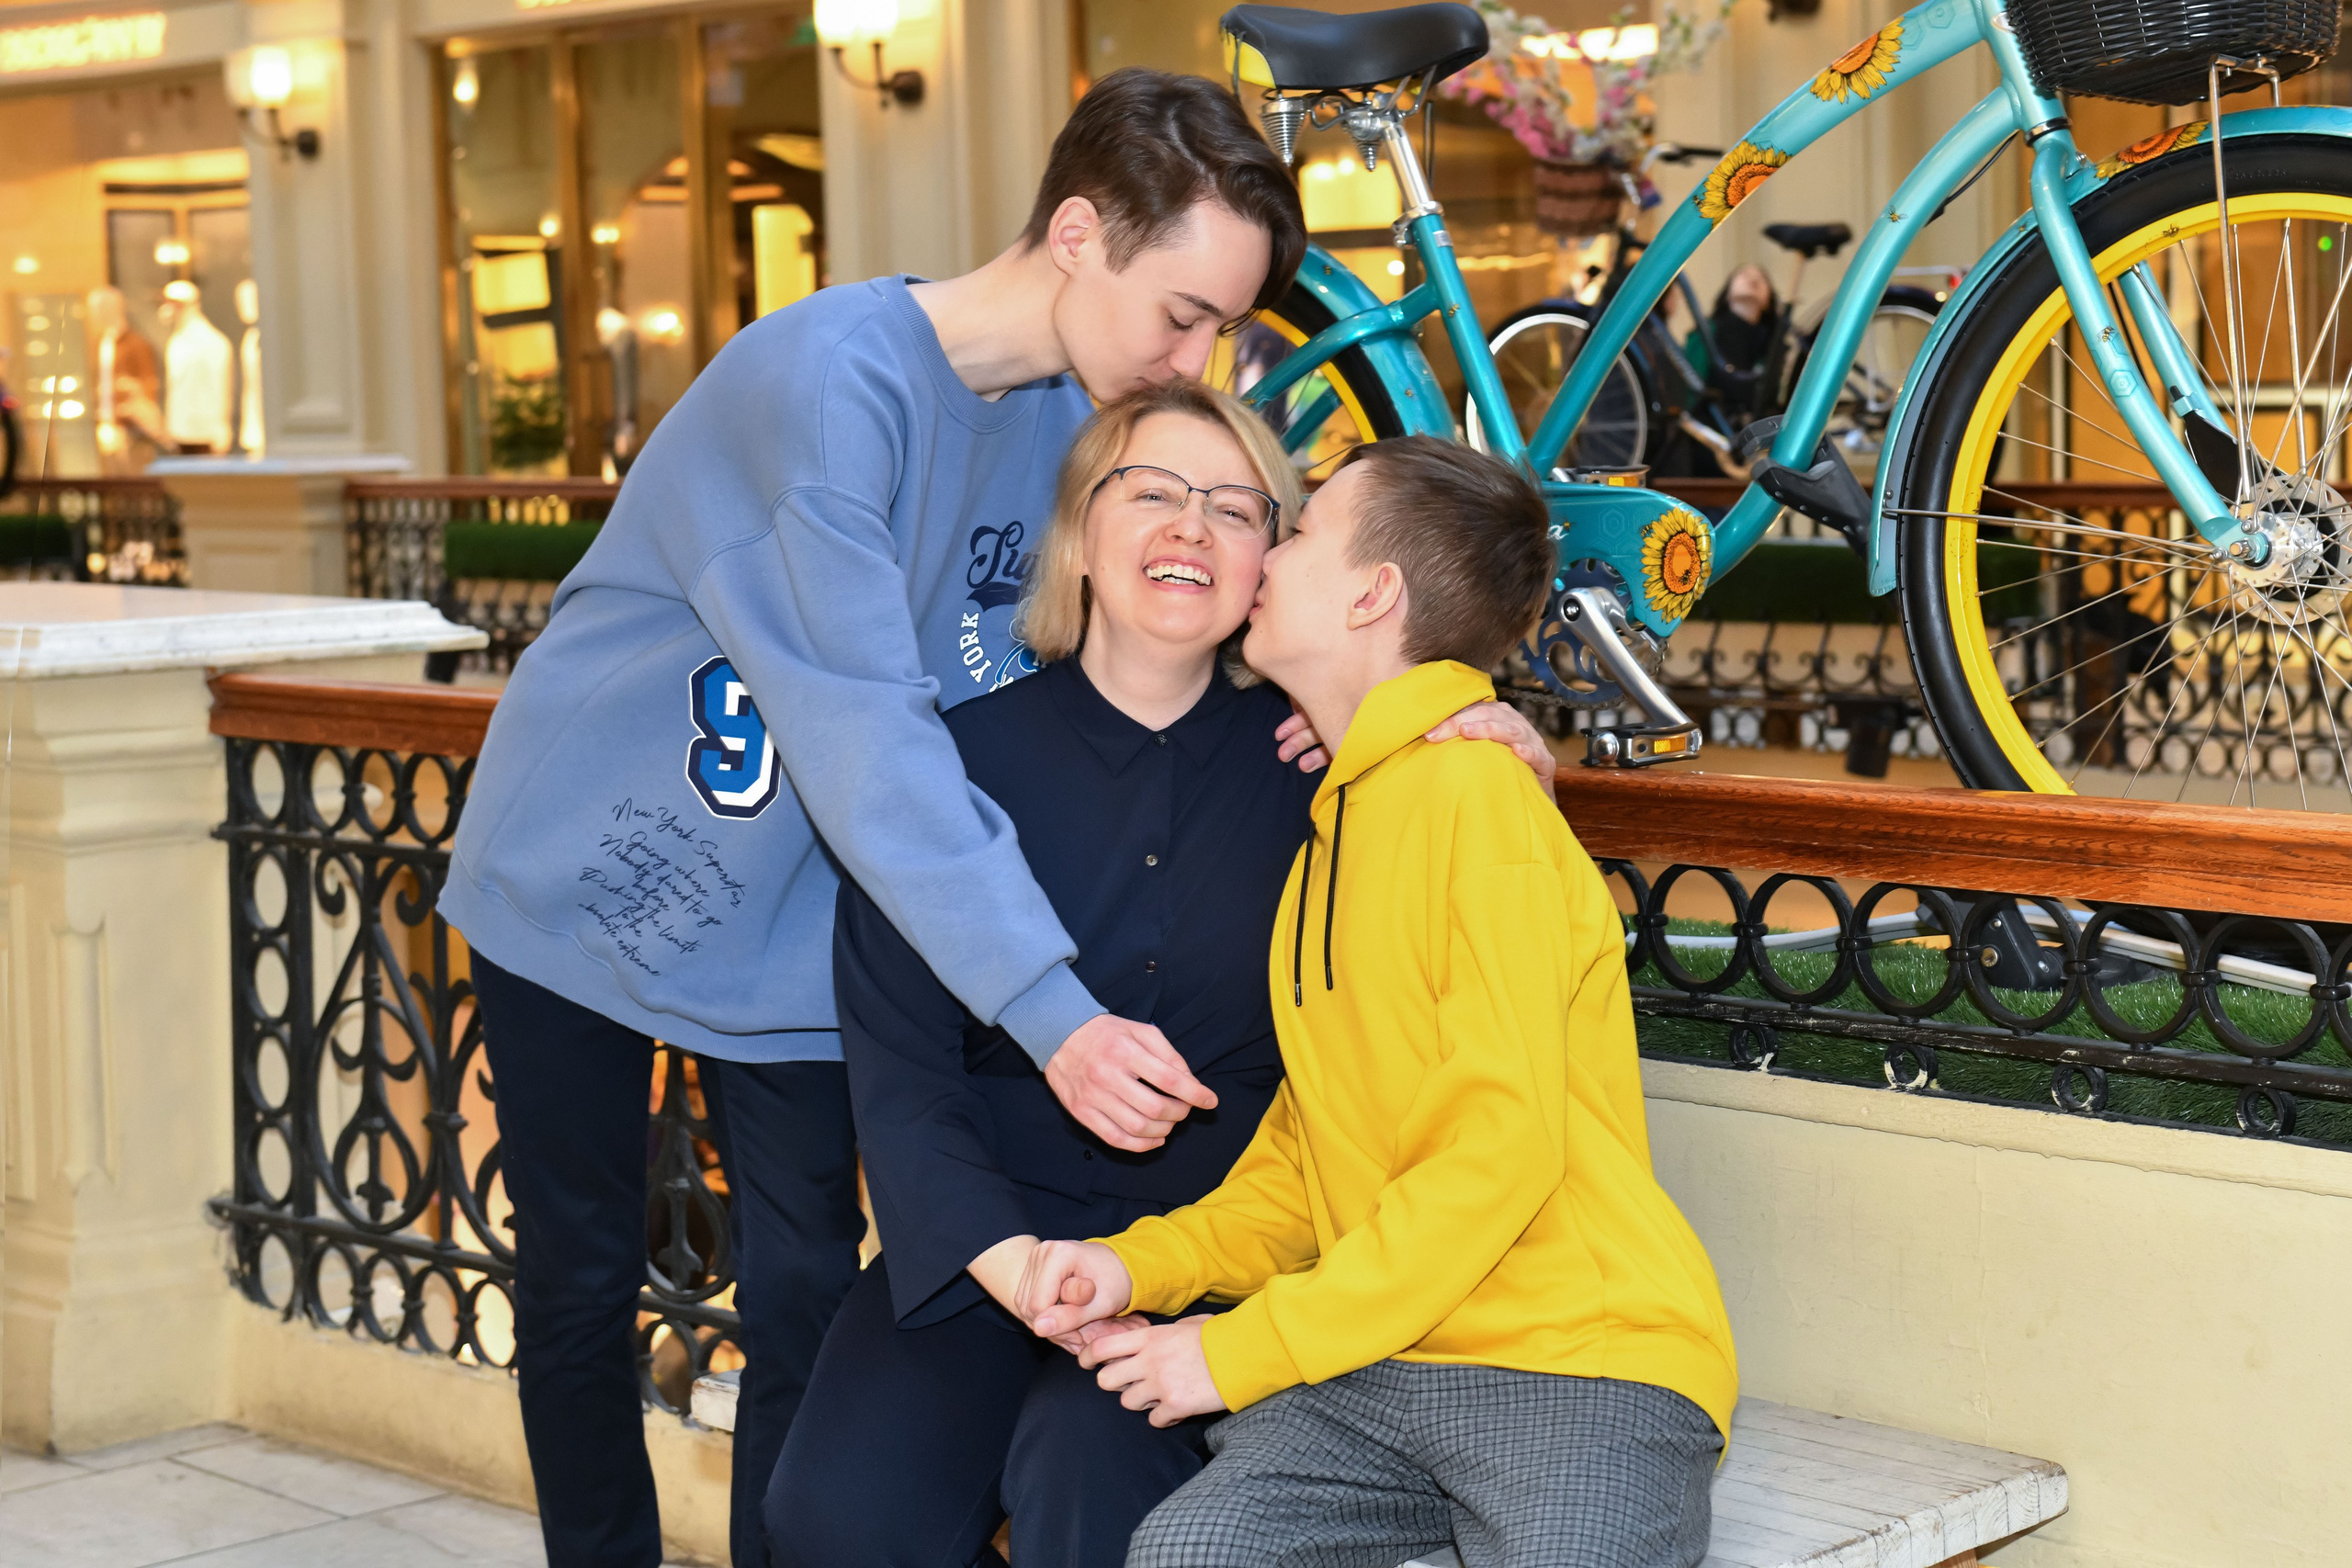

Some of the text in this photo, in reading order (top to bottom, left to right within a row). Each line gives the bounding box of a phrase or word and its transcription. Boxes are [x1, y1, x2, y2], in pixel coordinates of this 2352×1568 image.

[959, 612, 992, 683] YORK
[599, 833, 724, 928] Nobody dared to go
[612, 797, 746, 908] New York Superstar
[626, 831, 710, 897] Going where
[614, 904, 642, 938] to the
[632, 878, 670, 911] before
[642, 905, 662, 928] the
[658, 925, 704, 954] limits
